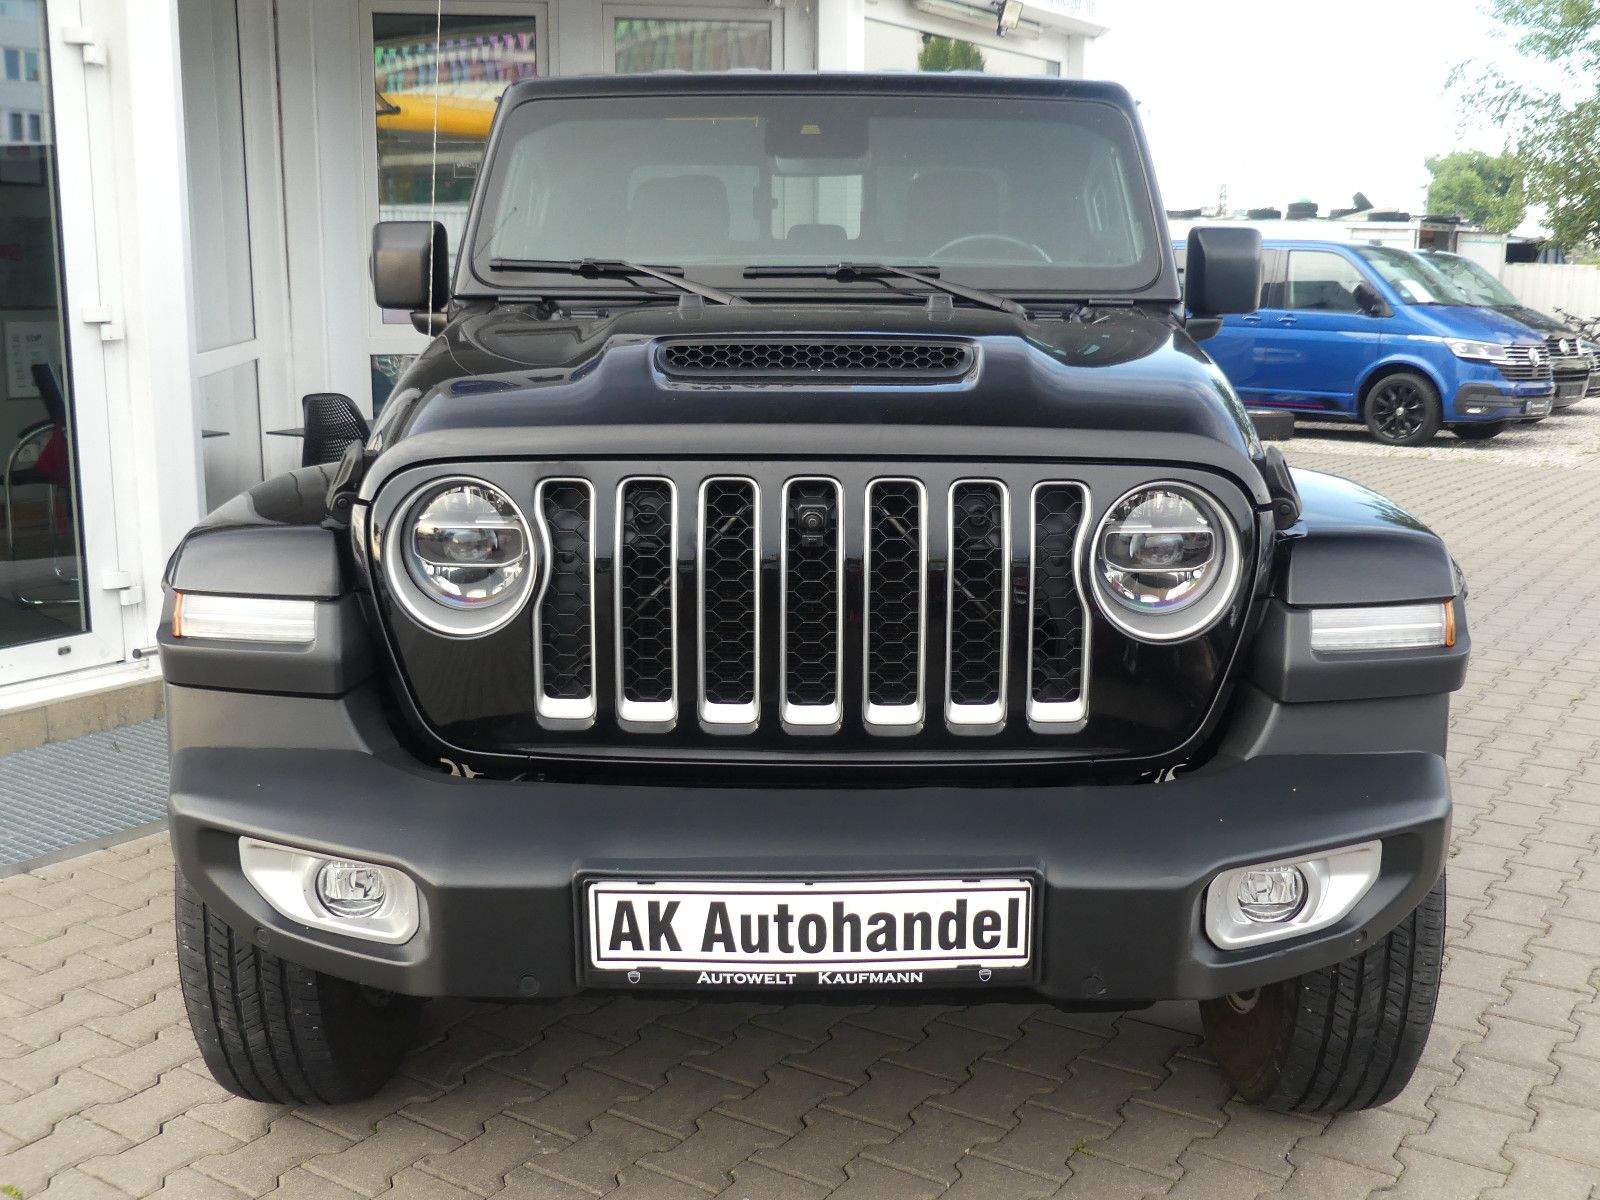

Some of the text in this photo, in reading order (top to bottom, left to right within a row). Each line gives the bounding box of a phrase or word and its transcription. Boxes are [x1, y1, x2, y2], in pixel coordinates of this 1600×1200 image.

[608, 897, 1020, 954] AK Autohandel
[696, 971, 924, 985] AUTOWELT KAUFMANN
